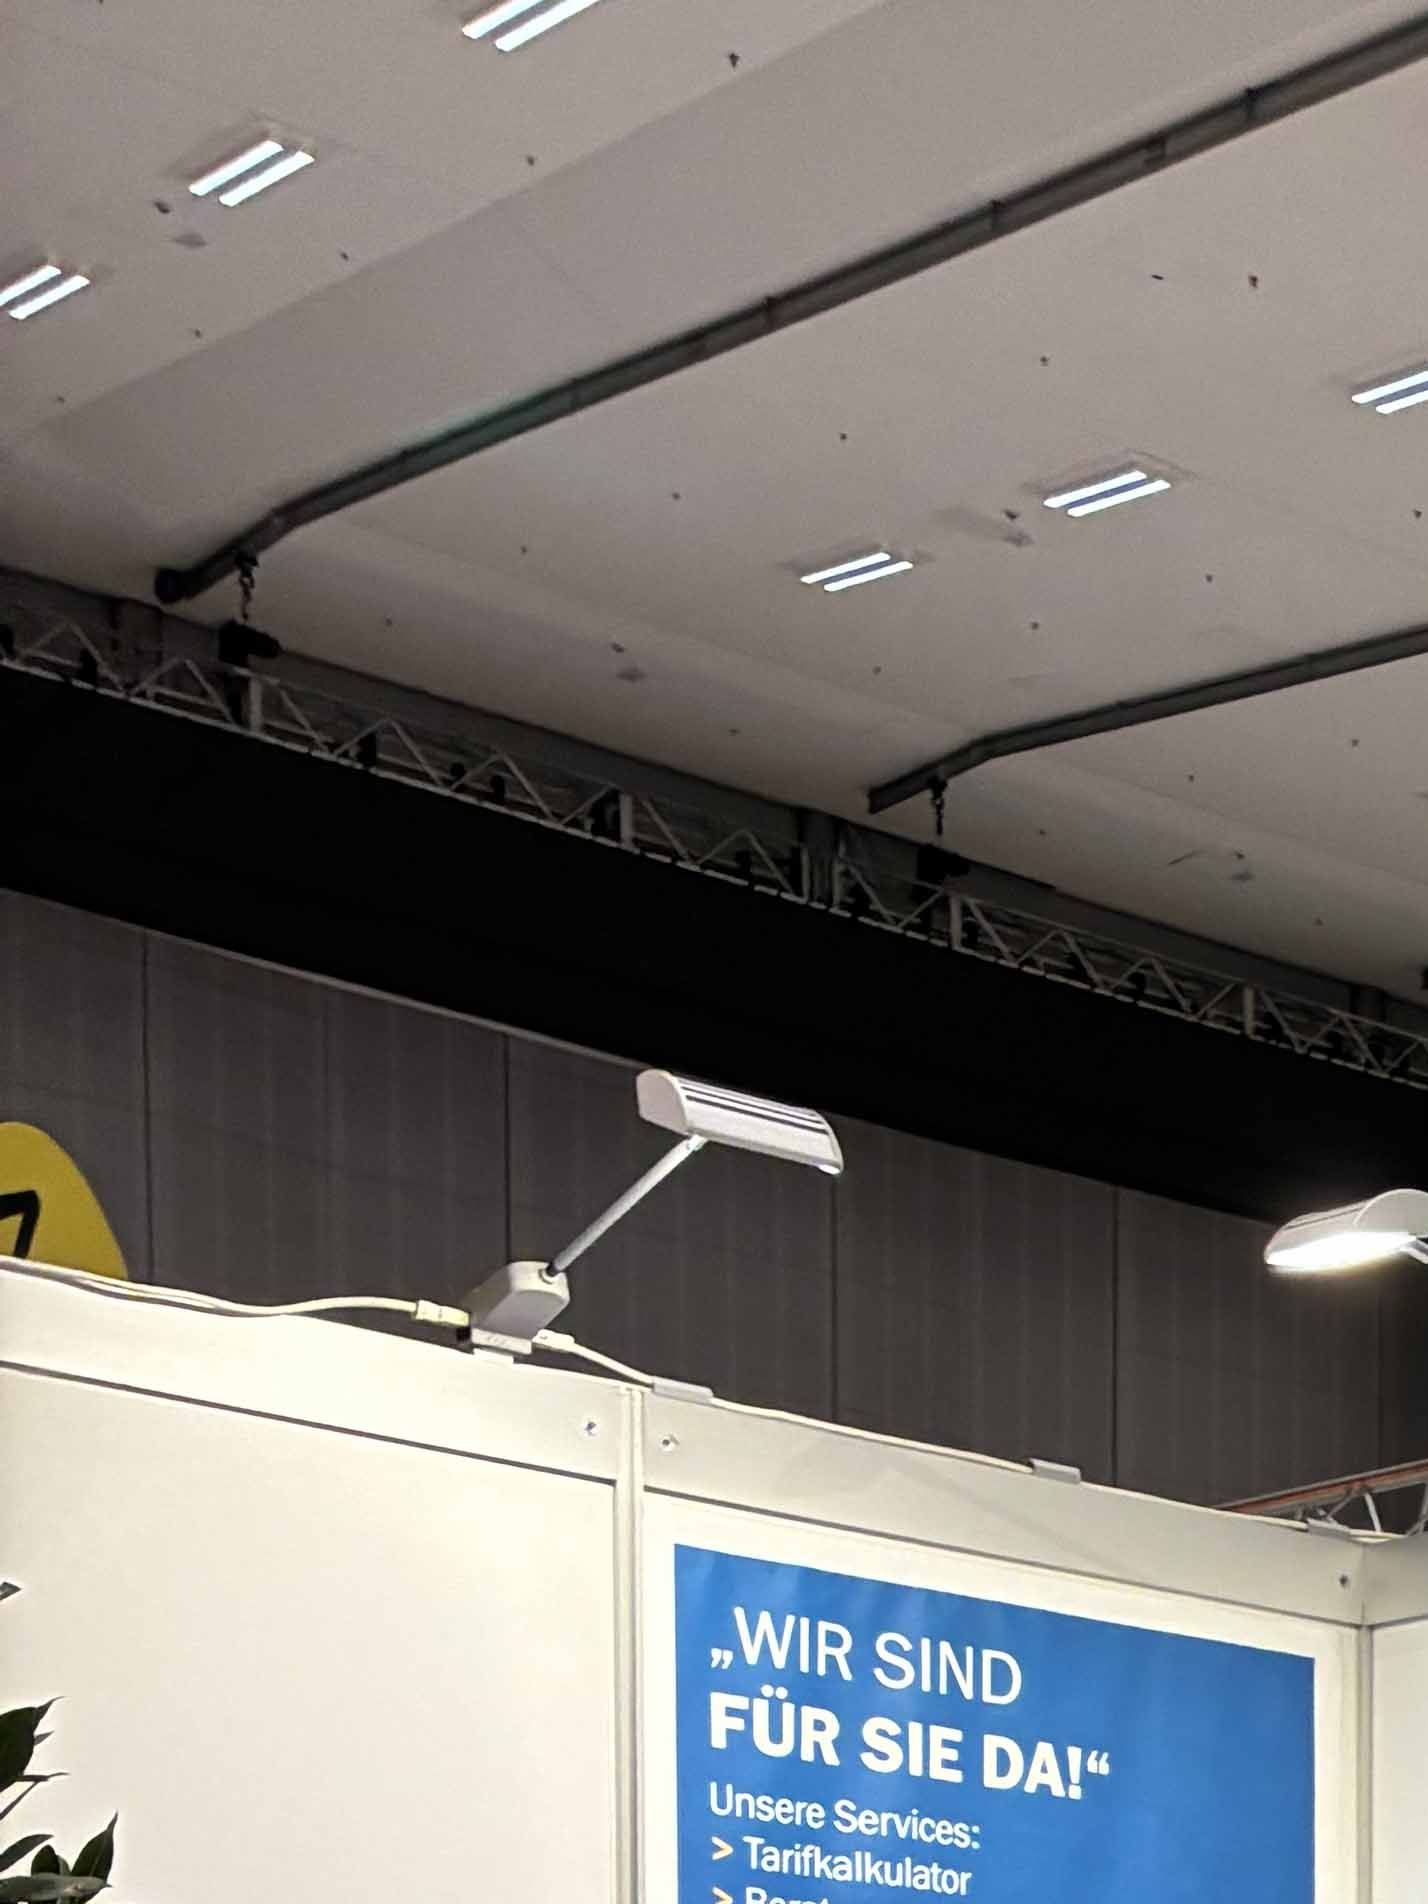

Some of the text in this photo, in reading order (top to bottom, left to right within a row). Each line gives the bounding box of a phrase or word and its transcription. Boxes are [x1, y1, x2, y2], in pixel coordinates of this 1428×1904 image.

[711, 1606, 1022, 1706] „WIR SIND
[709, 1686, 1111, 1799] FÜR SIE DA!“
[709, 1782, 980, 1849] Unsere Services:
[744, 1836, 971, 1896] Tarifkalkulator
